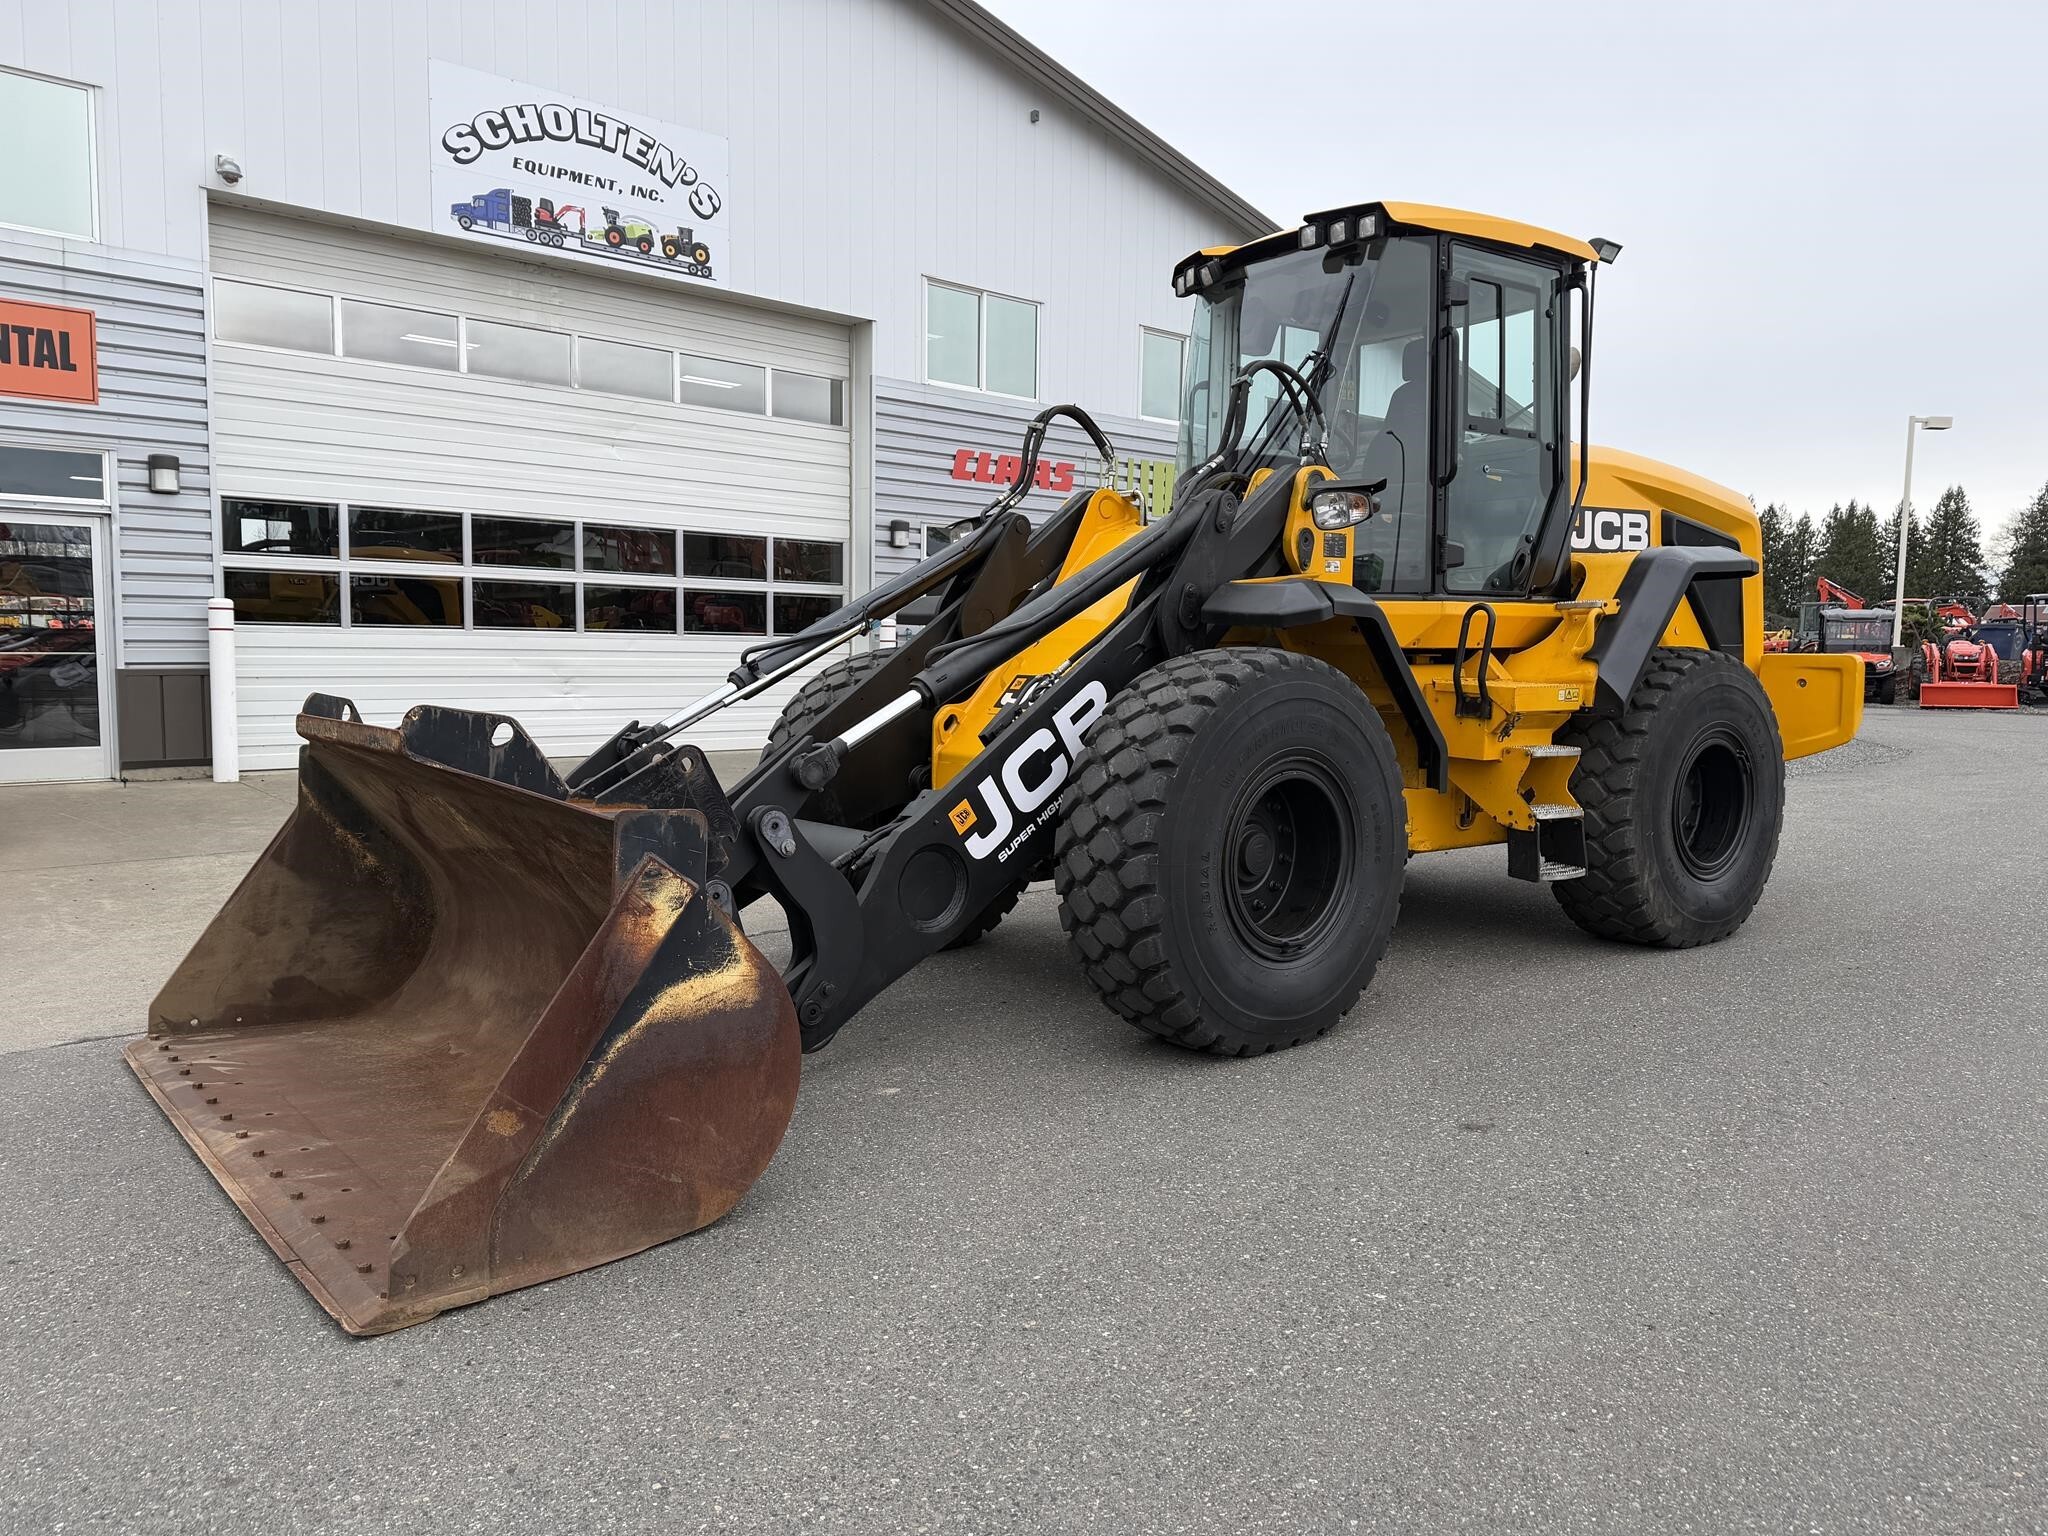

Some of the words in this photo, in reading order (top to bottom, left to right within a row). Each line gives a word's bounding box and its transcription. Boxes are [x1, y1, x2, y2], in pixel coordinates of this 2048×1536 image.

[442, 103, 721, 220] SCHOLTEN'S
[512, 156, 623, 195] EQUIPMENT,
[630, 184, 664, 203] INC.
[1571, 510, 1649, 550] JCB
[956, 809, 970, 825] JCB
[998, 823, 1036, 862] SUPER
[1036, 794, 1064, 825] HIGH
